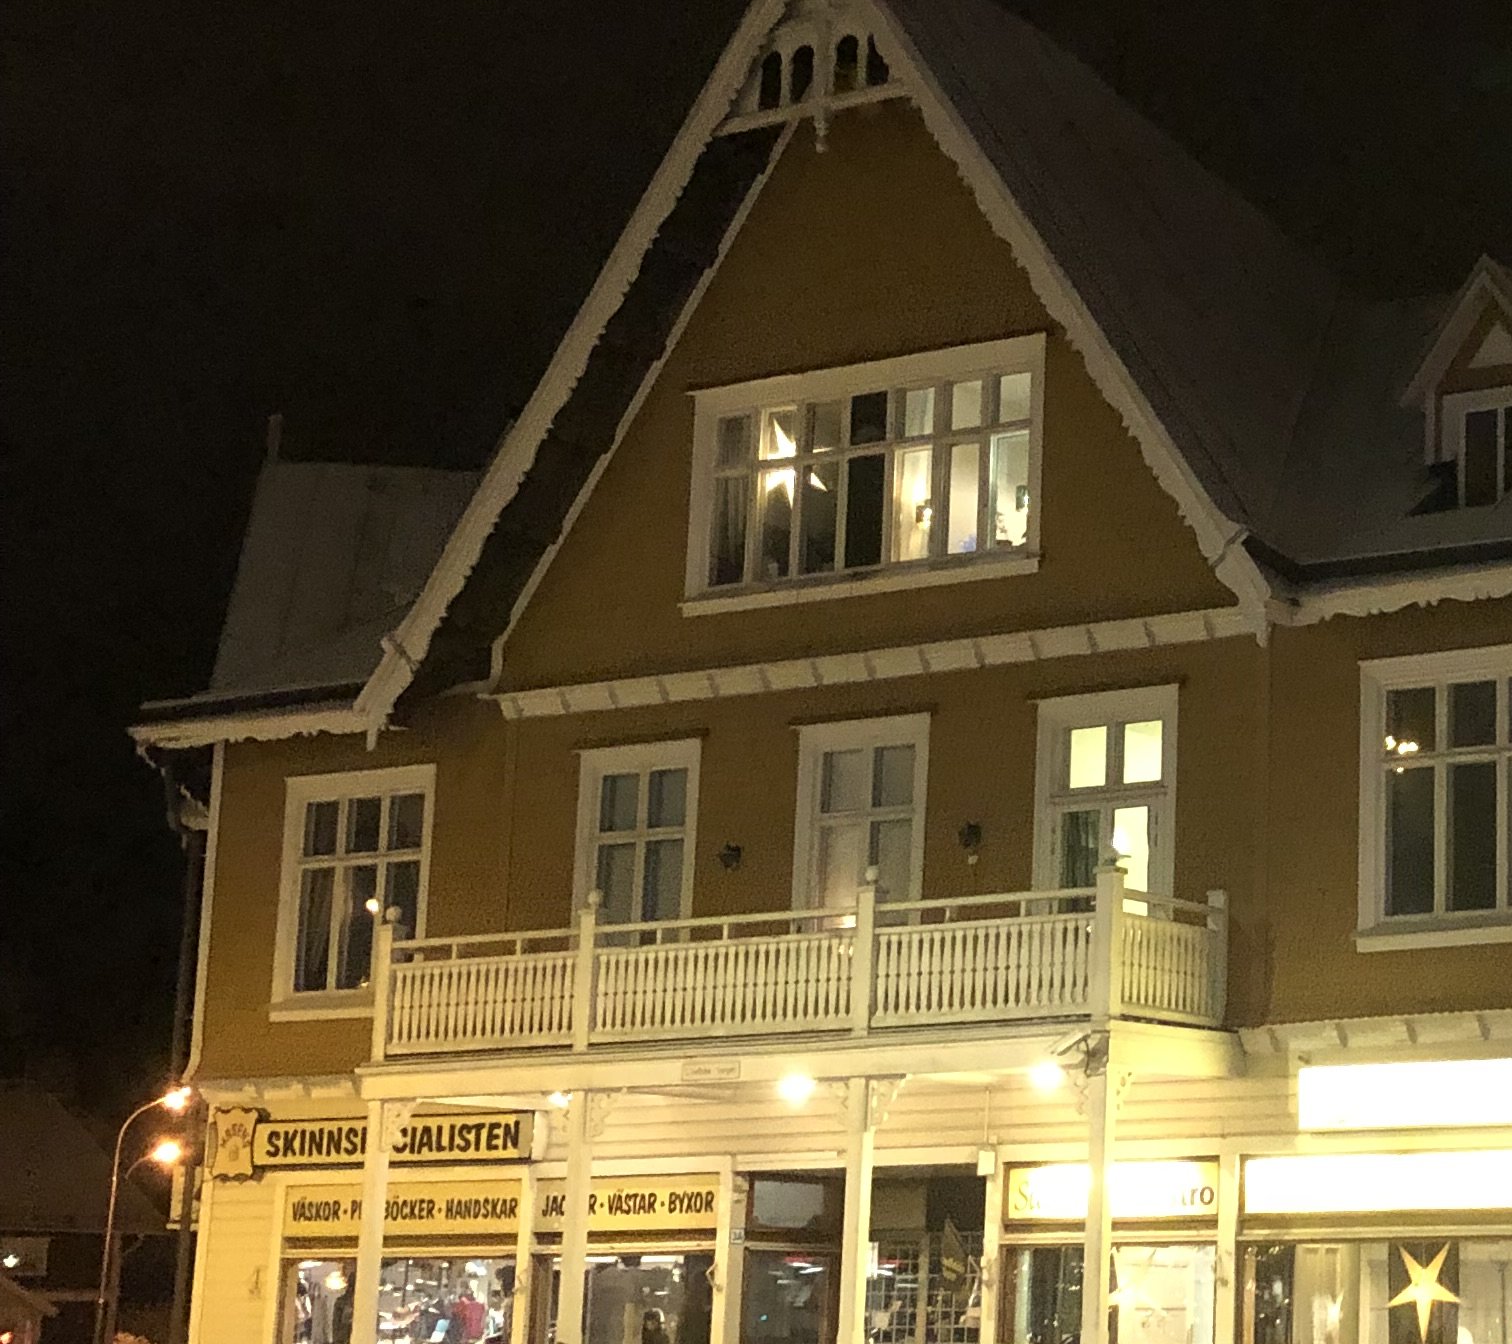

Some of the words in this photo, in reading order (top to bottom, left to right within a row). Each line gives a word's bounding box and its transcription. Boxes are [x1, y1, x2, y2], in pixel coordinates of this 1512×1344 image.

[266, 1120, 520, 1157] SKINNSCIALISTEN
[292, 1196, 340, 1222] VÄSKOR
[445, 1197, 518, 1219] HANDSKAR
[607, 1188, 657, 1215] VÄSTAR
[667, 1191, 715, 1214] BYXOR
